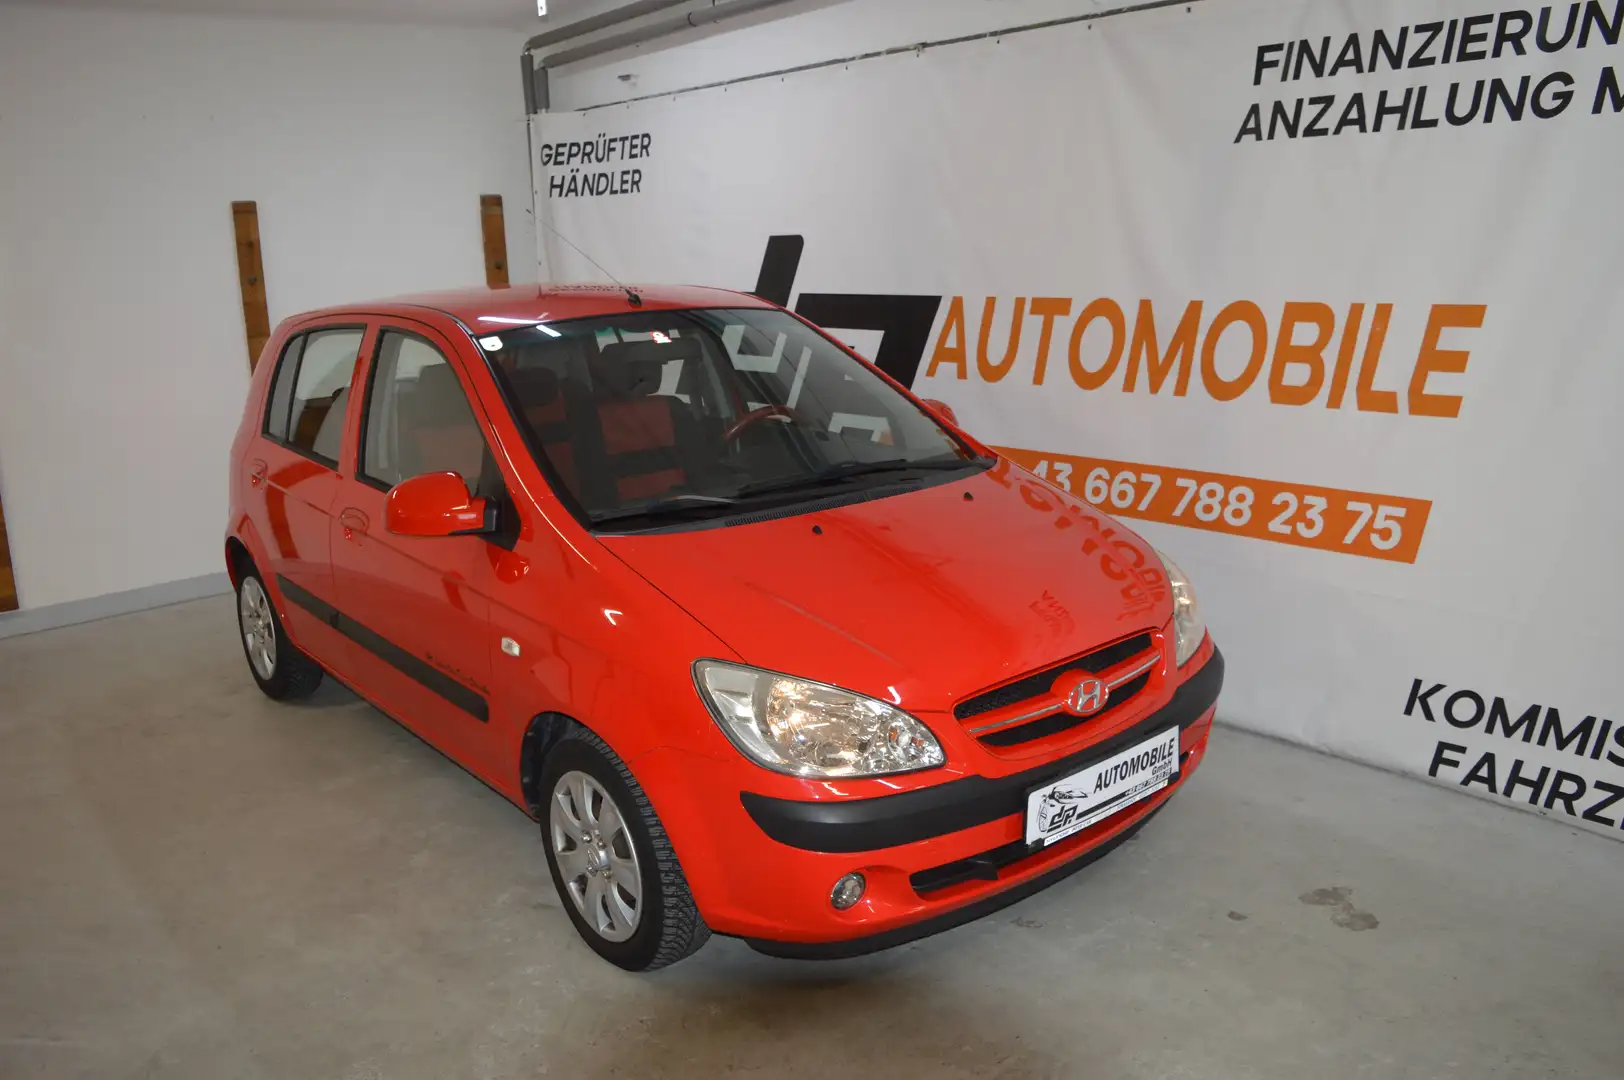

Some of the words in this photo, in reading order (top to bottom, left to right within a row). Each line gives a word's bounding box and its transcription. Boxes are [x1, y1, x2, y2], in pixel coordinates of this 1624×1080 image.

[1234, 71, 1575, 144] ANZAHLUNG
[540, 132, 651, 166] GEPRÜFTER
[549, 168, 642, 198] HÄNDLER
[925, 296, 1487, 418] AUTOMOBILE
[1084, 467, 1162, 511] 667
[1172, 478, 1256, 527] 788
[1268, 491, 1328, 539] 23
[1342, 501, 1407, 550] 75
[1093, 737, 1175, 794] AUTOMOBILE
[1152, 758, 1173, 776] GmbH
[1428, 741, 1624, 831] FAHRZ
